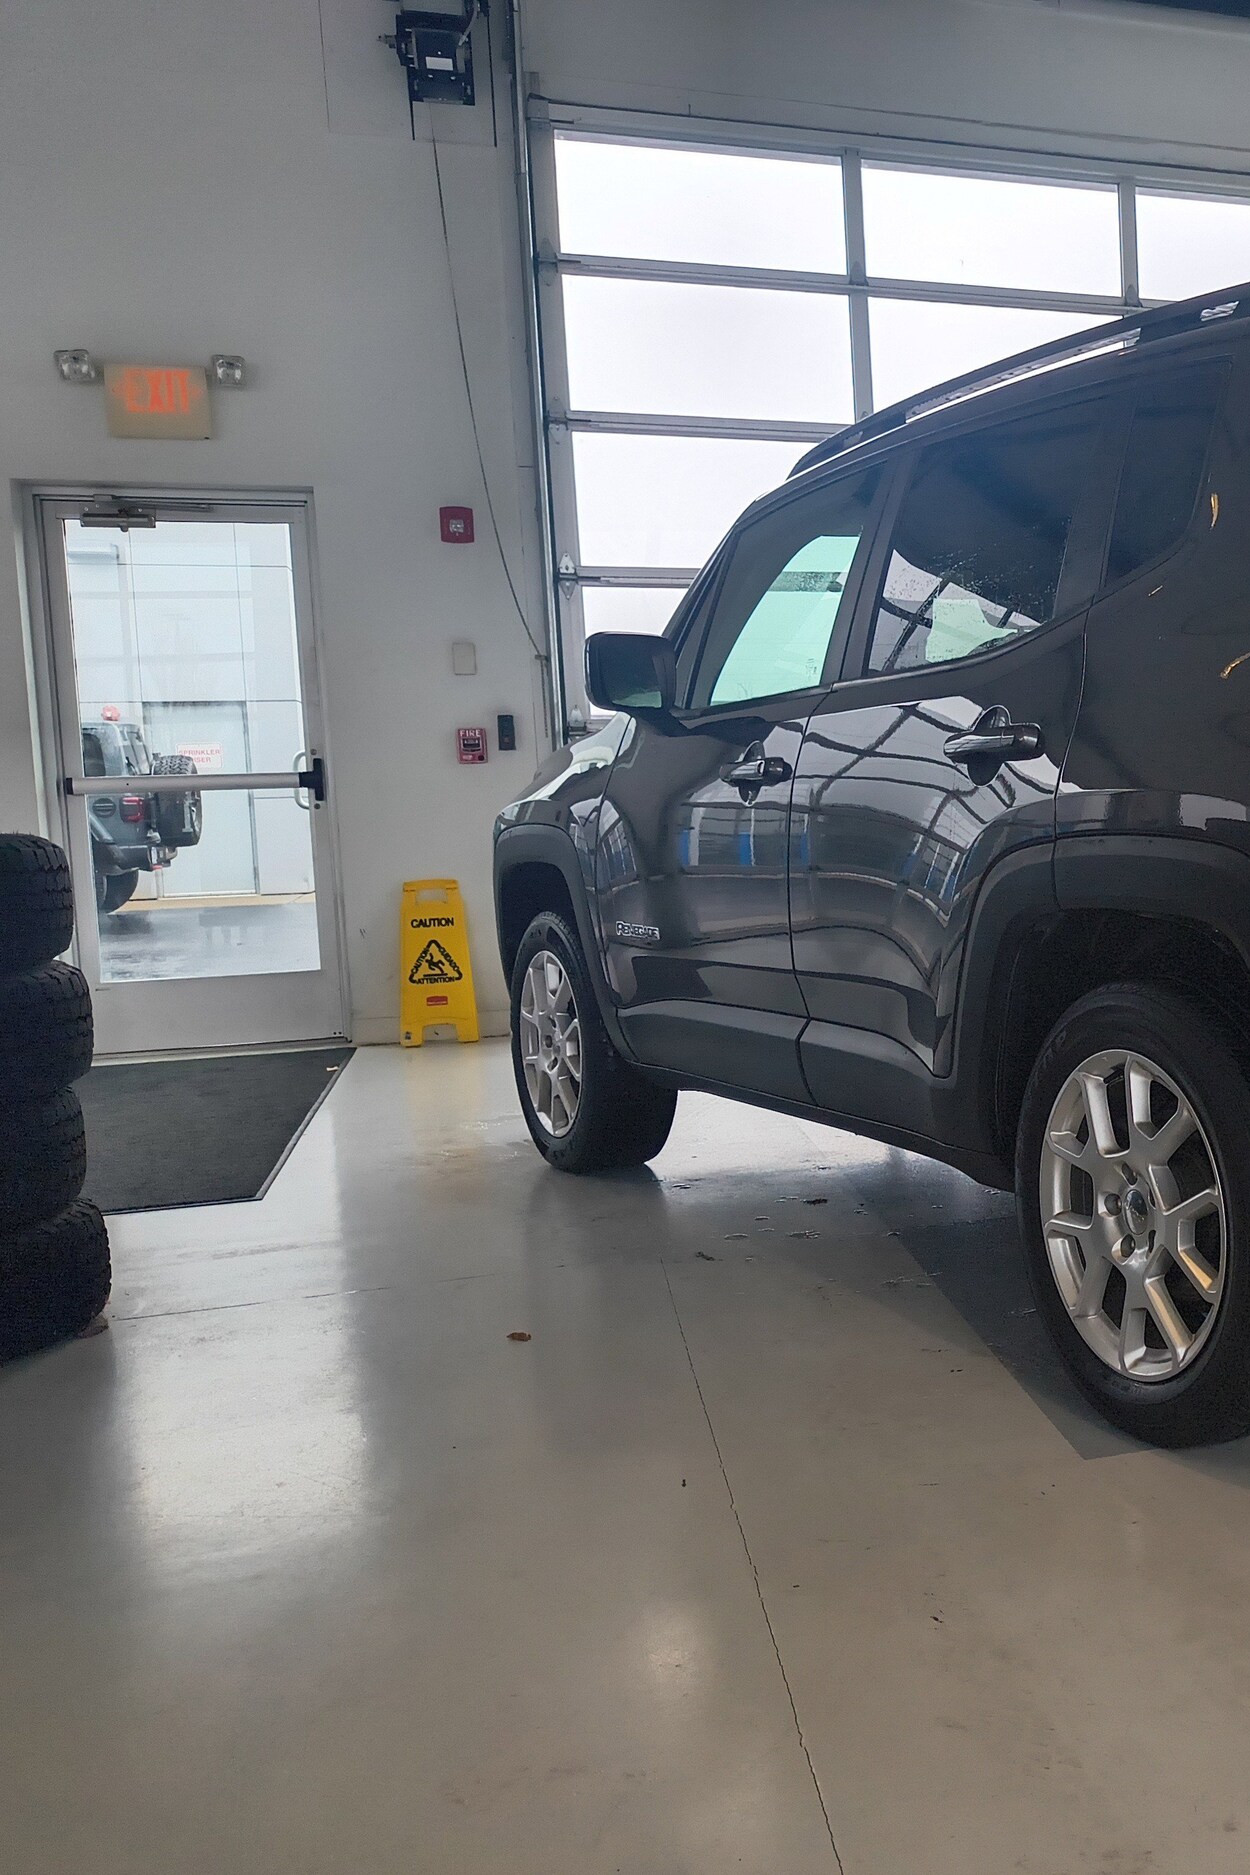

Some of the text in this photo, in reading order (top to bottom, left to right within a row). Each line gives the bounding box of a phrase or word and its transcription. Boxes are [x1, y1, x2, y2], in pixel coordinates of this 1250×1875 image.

[125, 367, 191, 415] EXIT
[460, 729, 481, 738] FIRE
[411, 917, 454, 928] CAUTION
[615, 920, 661, 940] RENEGADE
[410, 947, 430, 975] CAUTION
[415, 976, 456, 985] ATTENTION
